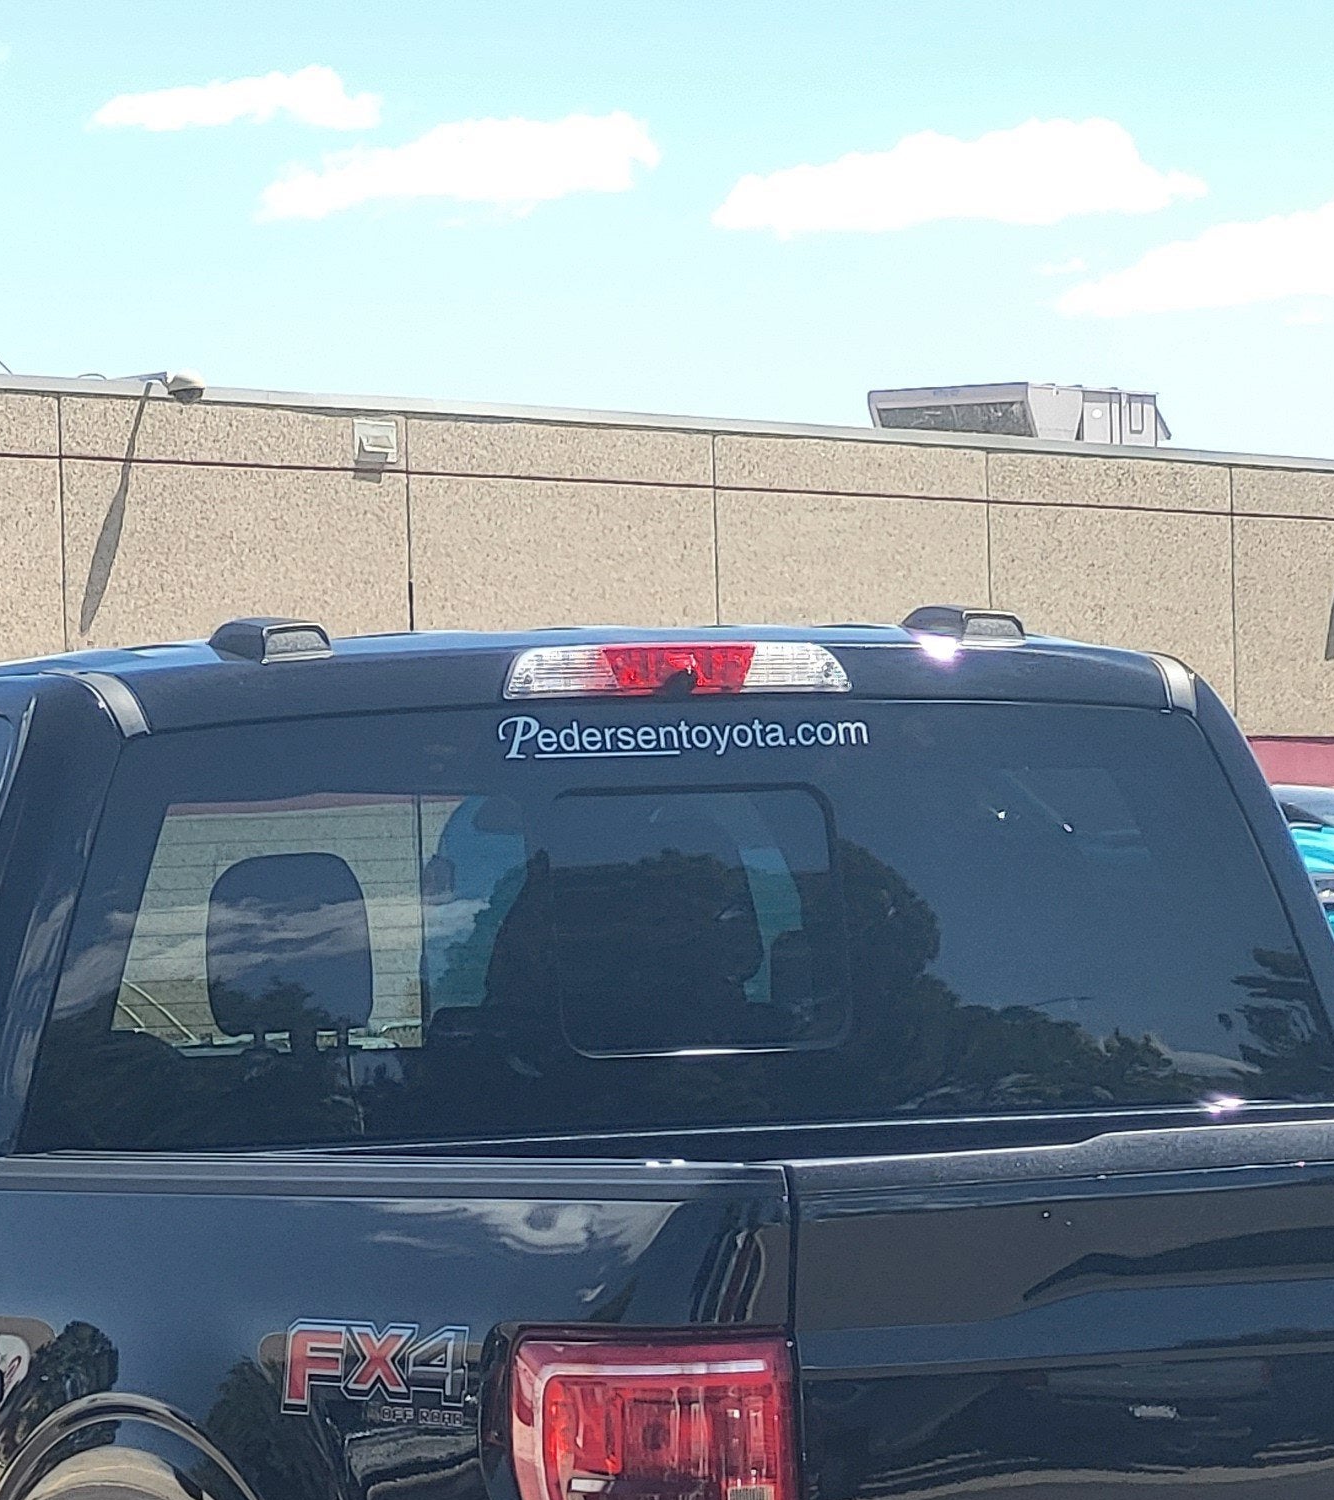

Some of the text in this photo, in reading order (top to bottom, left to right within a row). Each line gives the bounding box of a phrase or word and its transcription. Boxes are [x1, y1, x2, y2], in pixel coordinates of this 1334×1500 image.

[498, 715, 869, 760] Pedersentoyota.com
[280, 1317, 469, 1415] FX4
[380, 1406, 414, 1423] OFF
